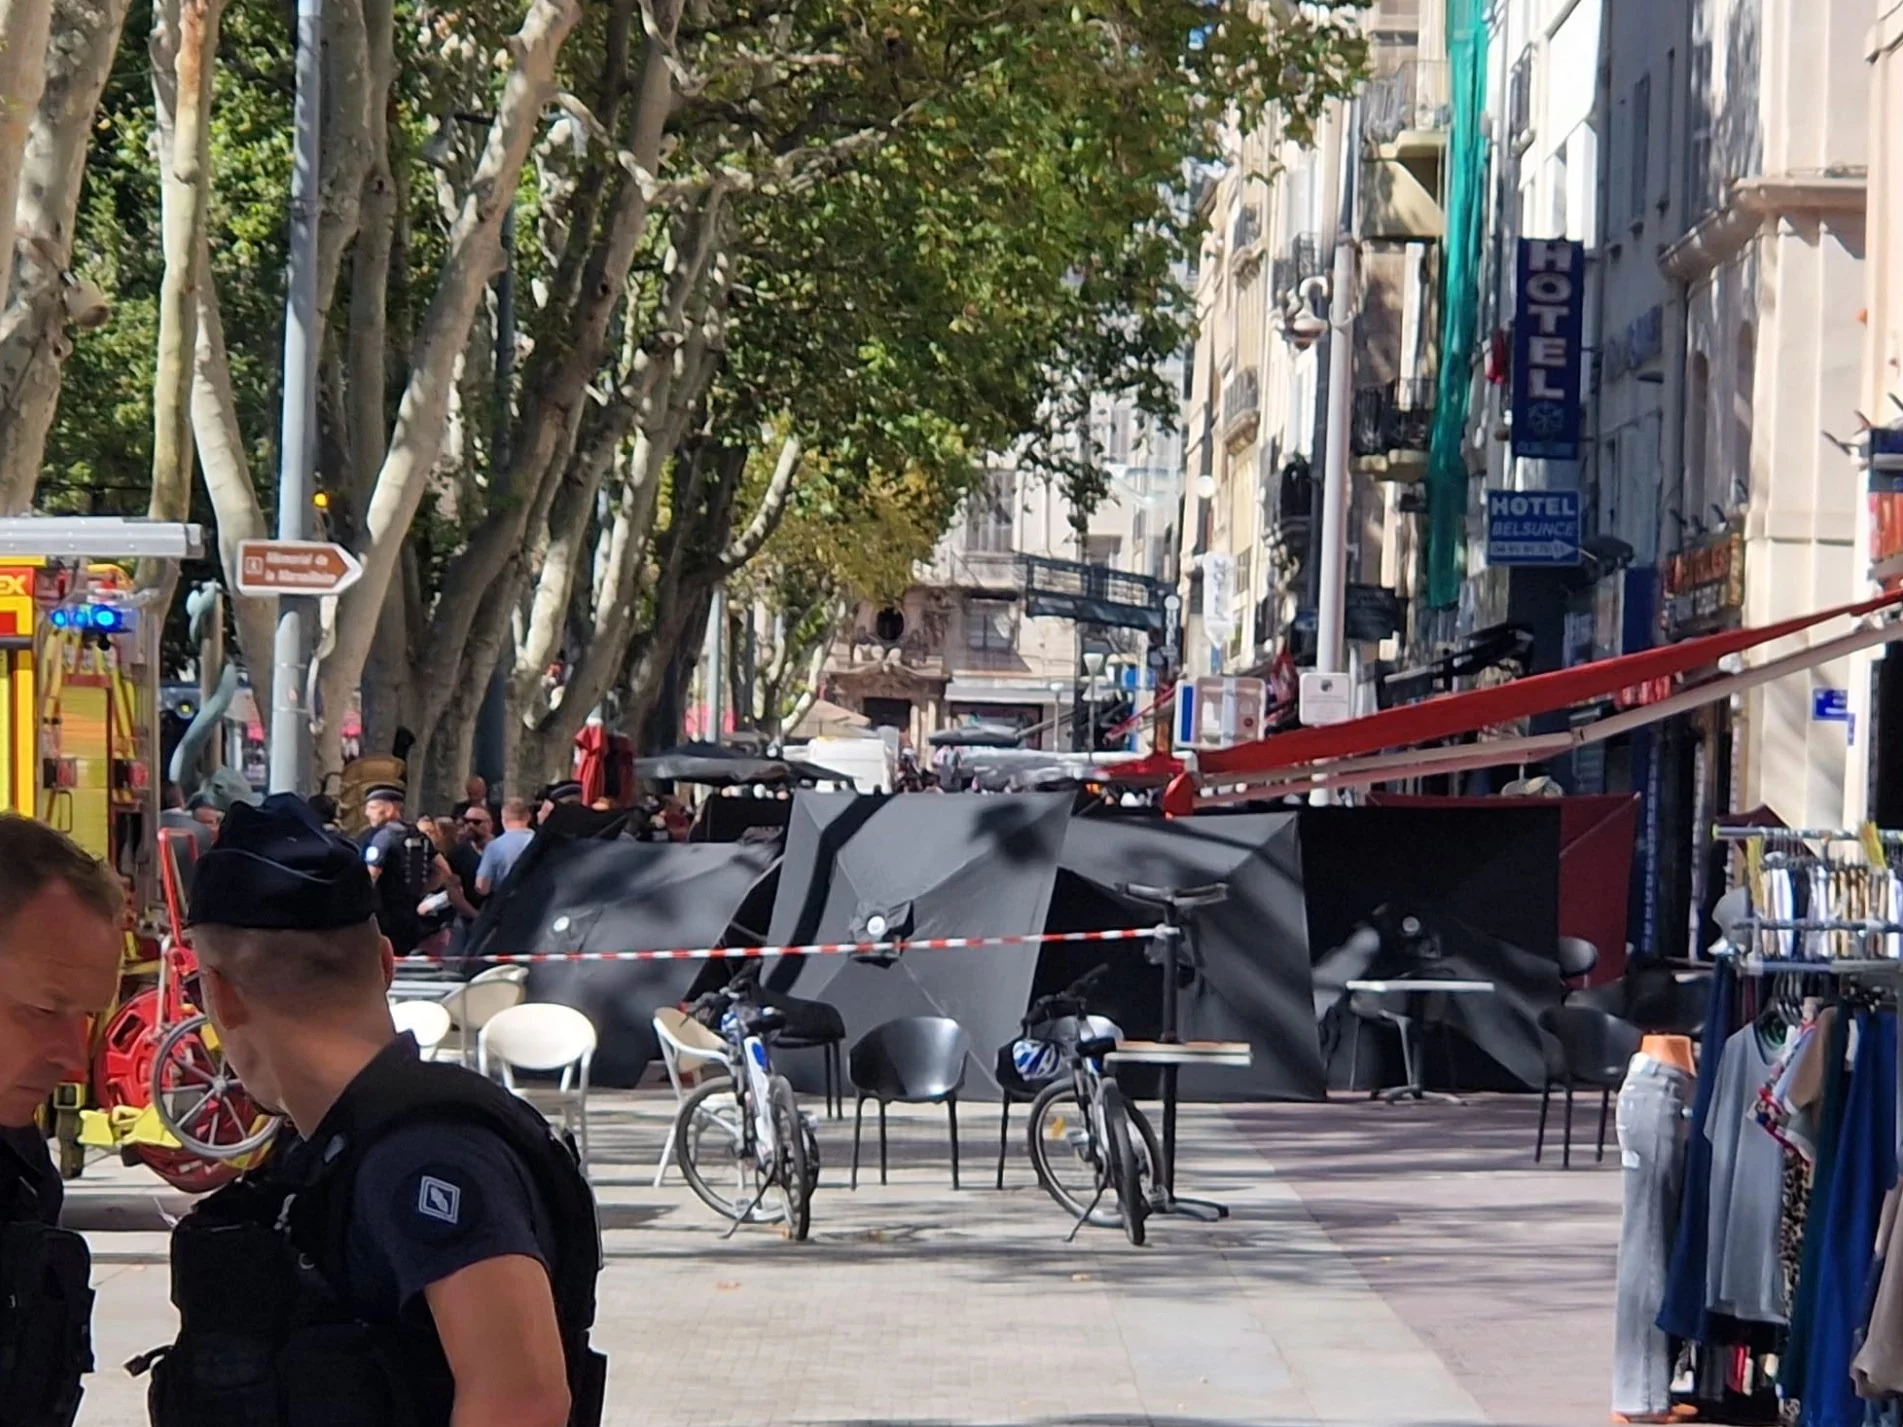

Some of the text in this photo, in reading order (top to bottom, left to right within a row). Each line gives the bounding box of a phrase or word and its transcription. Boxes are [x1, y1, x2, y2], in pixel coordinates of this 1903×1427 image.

[1525, 240, 1572, 399] HOTEL
[1491, 496, 1576, 516] HOTEL
[1492, 521, 1576, 537] BELSUNCE
